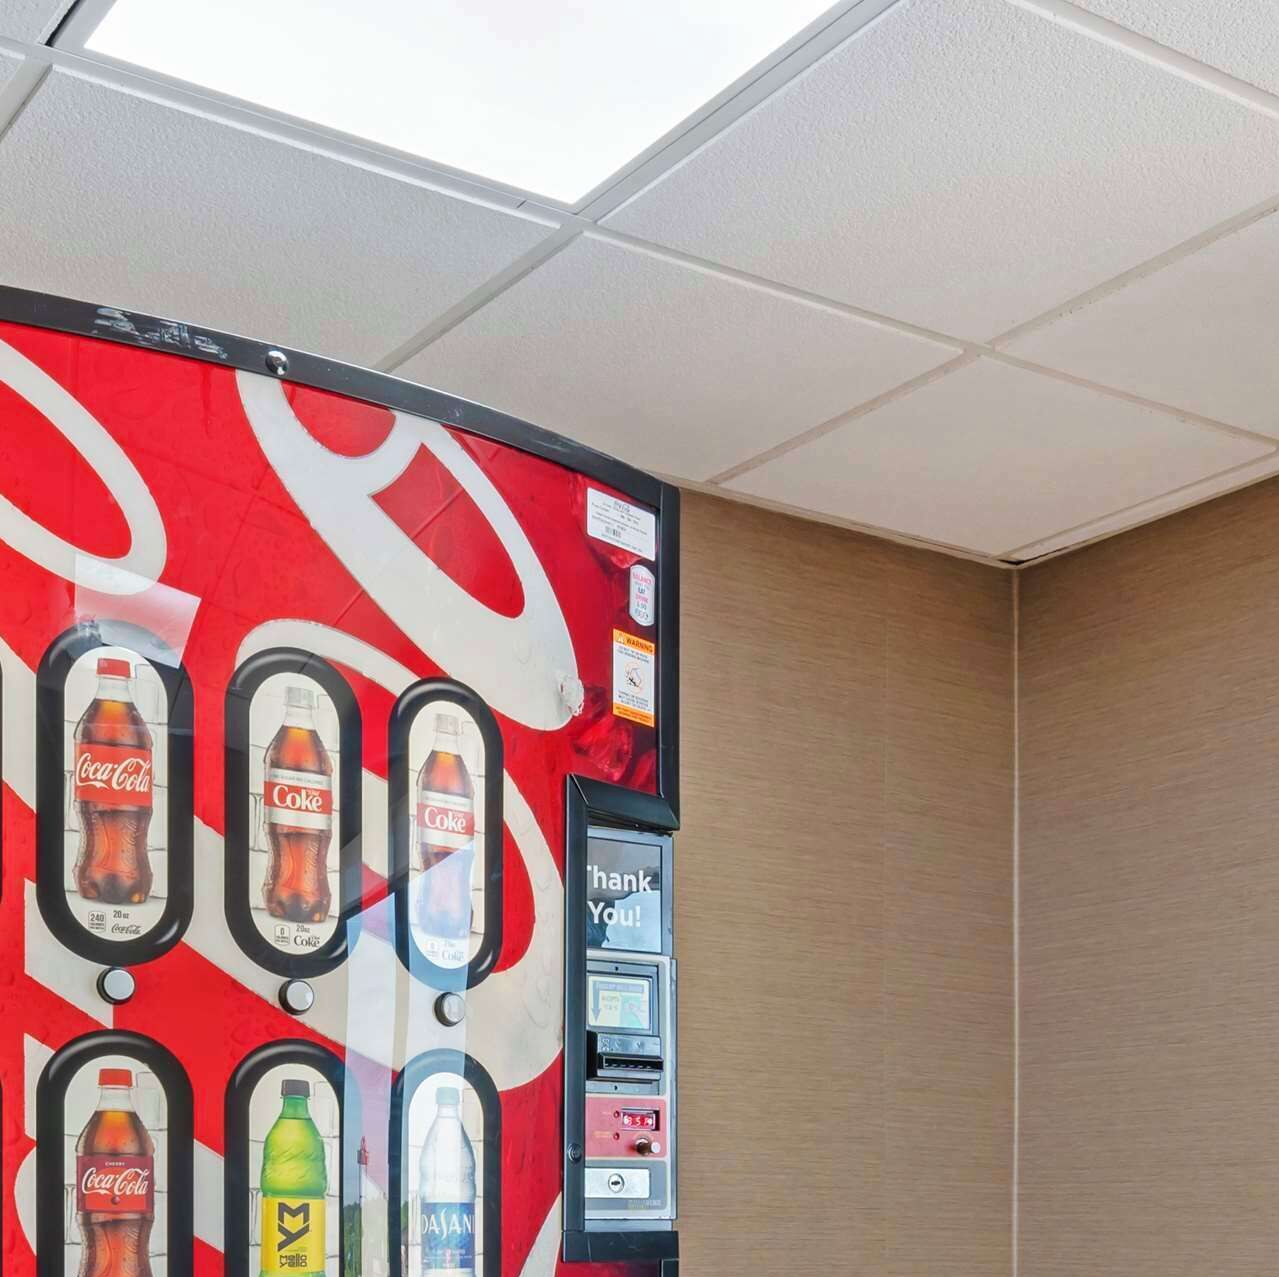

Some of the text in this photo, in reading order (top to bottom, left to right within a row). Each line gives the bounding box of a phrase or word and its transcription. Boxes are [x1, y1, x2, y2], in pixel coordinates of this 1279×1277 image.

[626, 636, 654, 653] WARNING
[75, 752, 152, 793] Coca-Cola
[273, 784, 323, 812] Coke
[424, 806, 467, 833] Coke
[90, 913, 105, 922] 240
[113, 910, 122, 919] 20
[586, 900, 641, 927] You!
[293, 934, 321, 948] Coke
[81, 1166, 150, 1196] Coca-Cola
